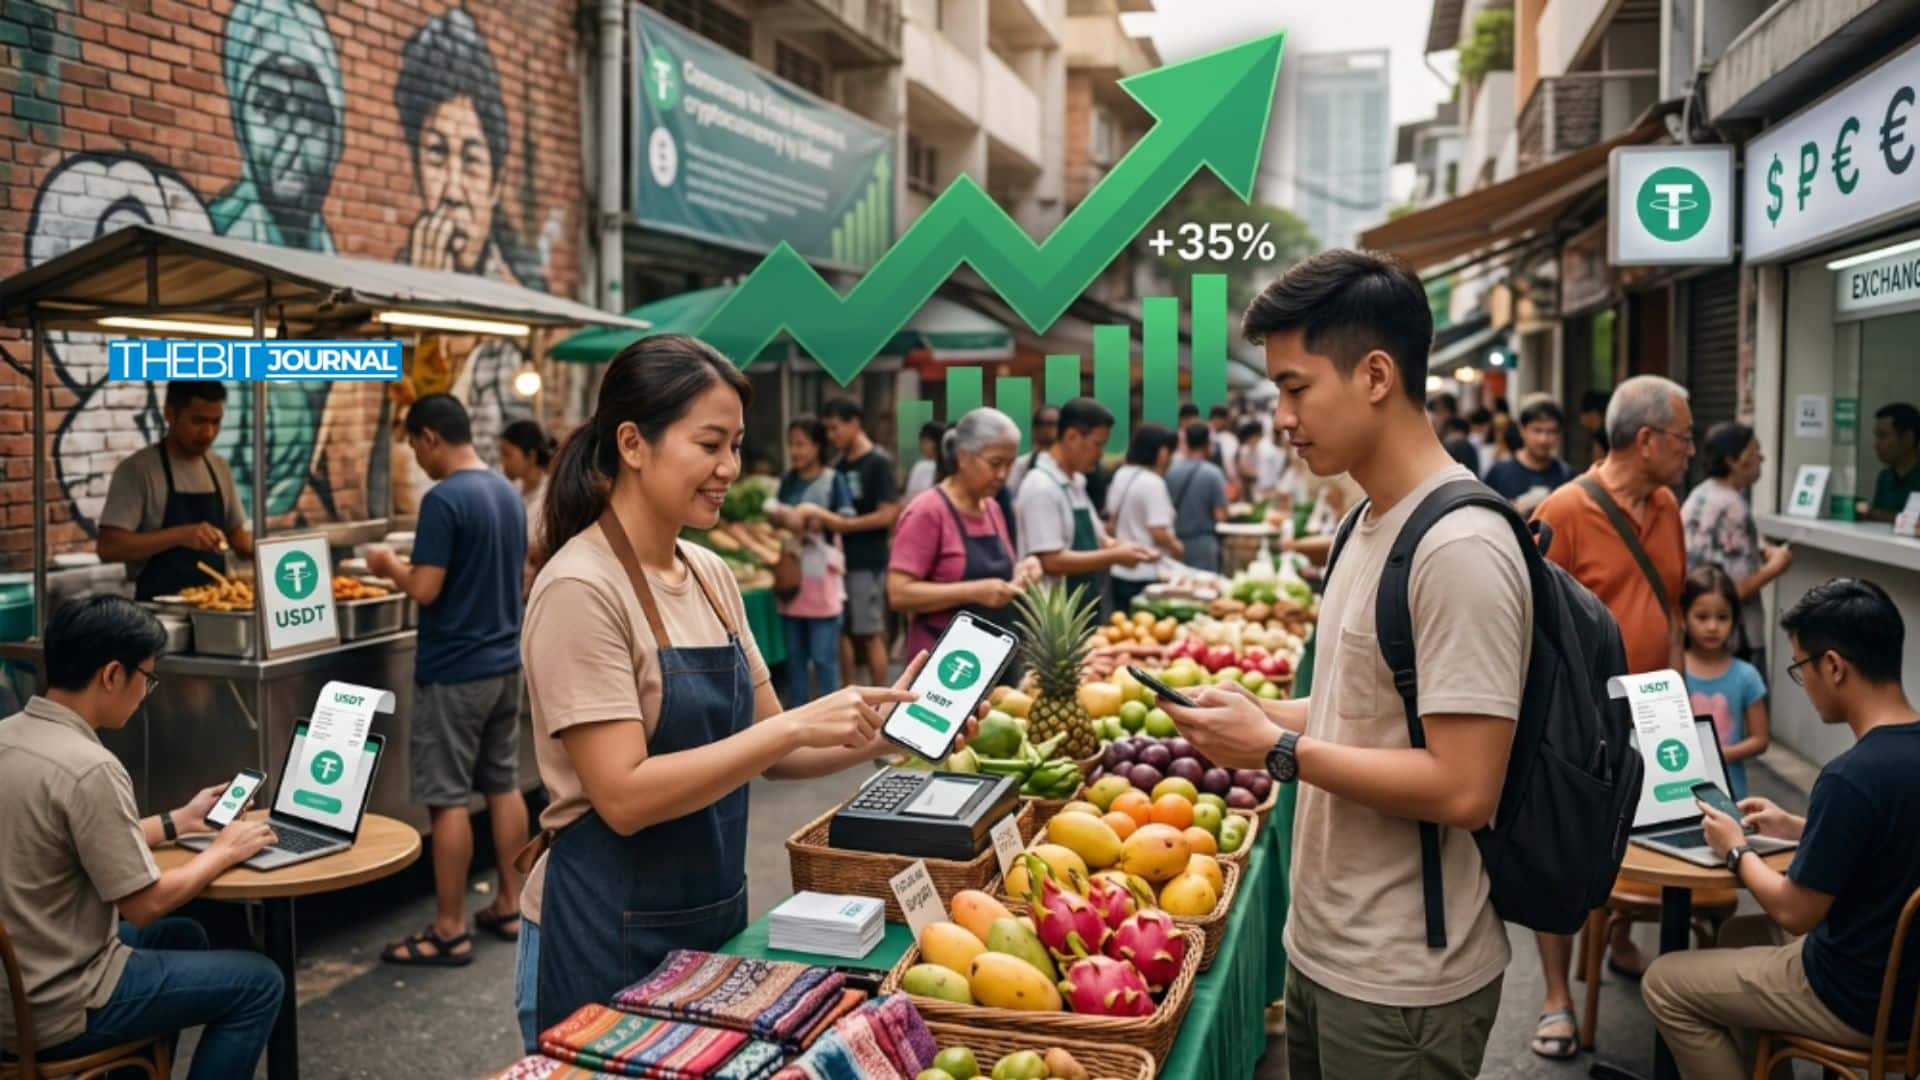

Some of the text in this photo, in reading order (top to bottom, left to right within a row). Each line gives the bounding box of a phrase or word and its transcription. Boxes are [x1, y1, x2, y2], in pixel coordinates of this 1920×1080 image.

[275, 604, 325, 628] USDT
[1640, 681, 1669, 694] USDT
[333, 692, 365, 707] USDT
